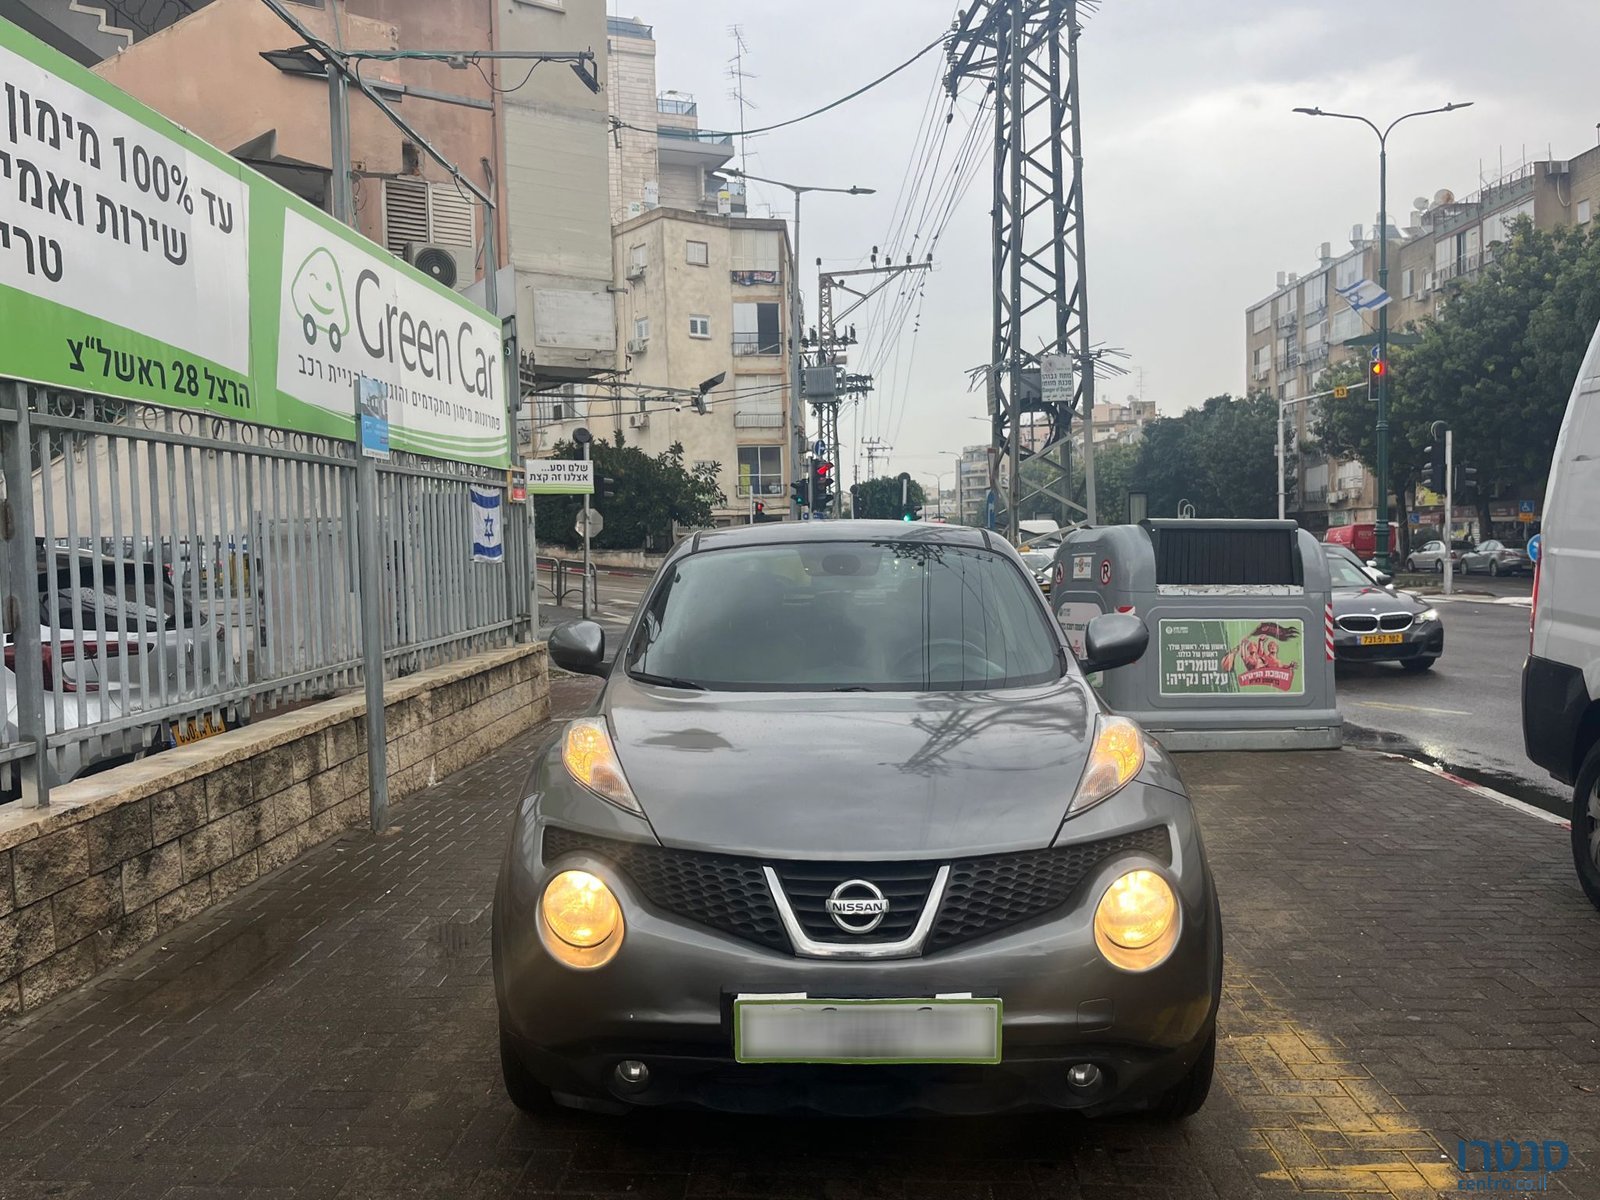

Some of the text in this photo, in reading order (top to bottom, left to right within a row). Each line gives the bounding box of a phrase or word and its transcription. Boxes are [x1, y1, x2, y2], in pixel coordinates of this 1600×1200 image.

[5, 81, 233, 234] עד 100% מימון
[96, 193, 187, 266] שירות
[355, 268, 496, 400] Green Car
[298, 354, 323, 380] רכב
[172, 360, 199, 397] 28
[203, 366, 250, 409] הרצל
[1336, 388, 1345, 396] 13
[412, 391, 451, 416] מתקדמים
[453, 403, 473, 423] מימון
[475, 410, 500, 431] פתרונות
[529, 472, 589, 483] אצלנו זה קצת
[541, 463, 588, 472] שלם וסע...
[1176, 659, 1218, 671] שומרים
[1166, 671, 1229, 687] עליה נקייה!
[832, 902, 883, 912] NISSAN
